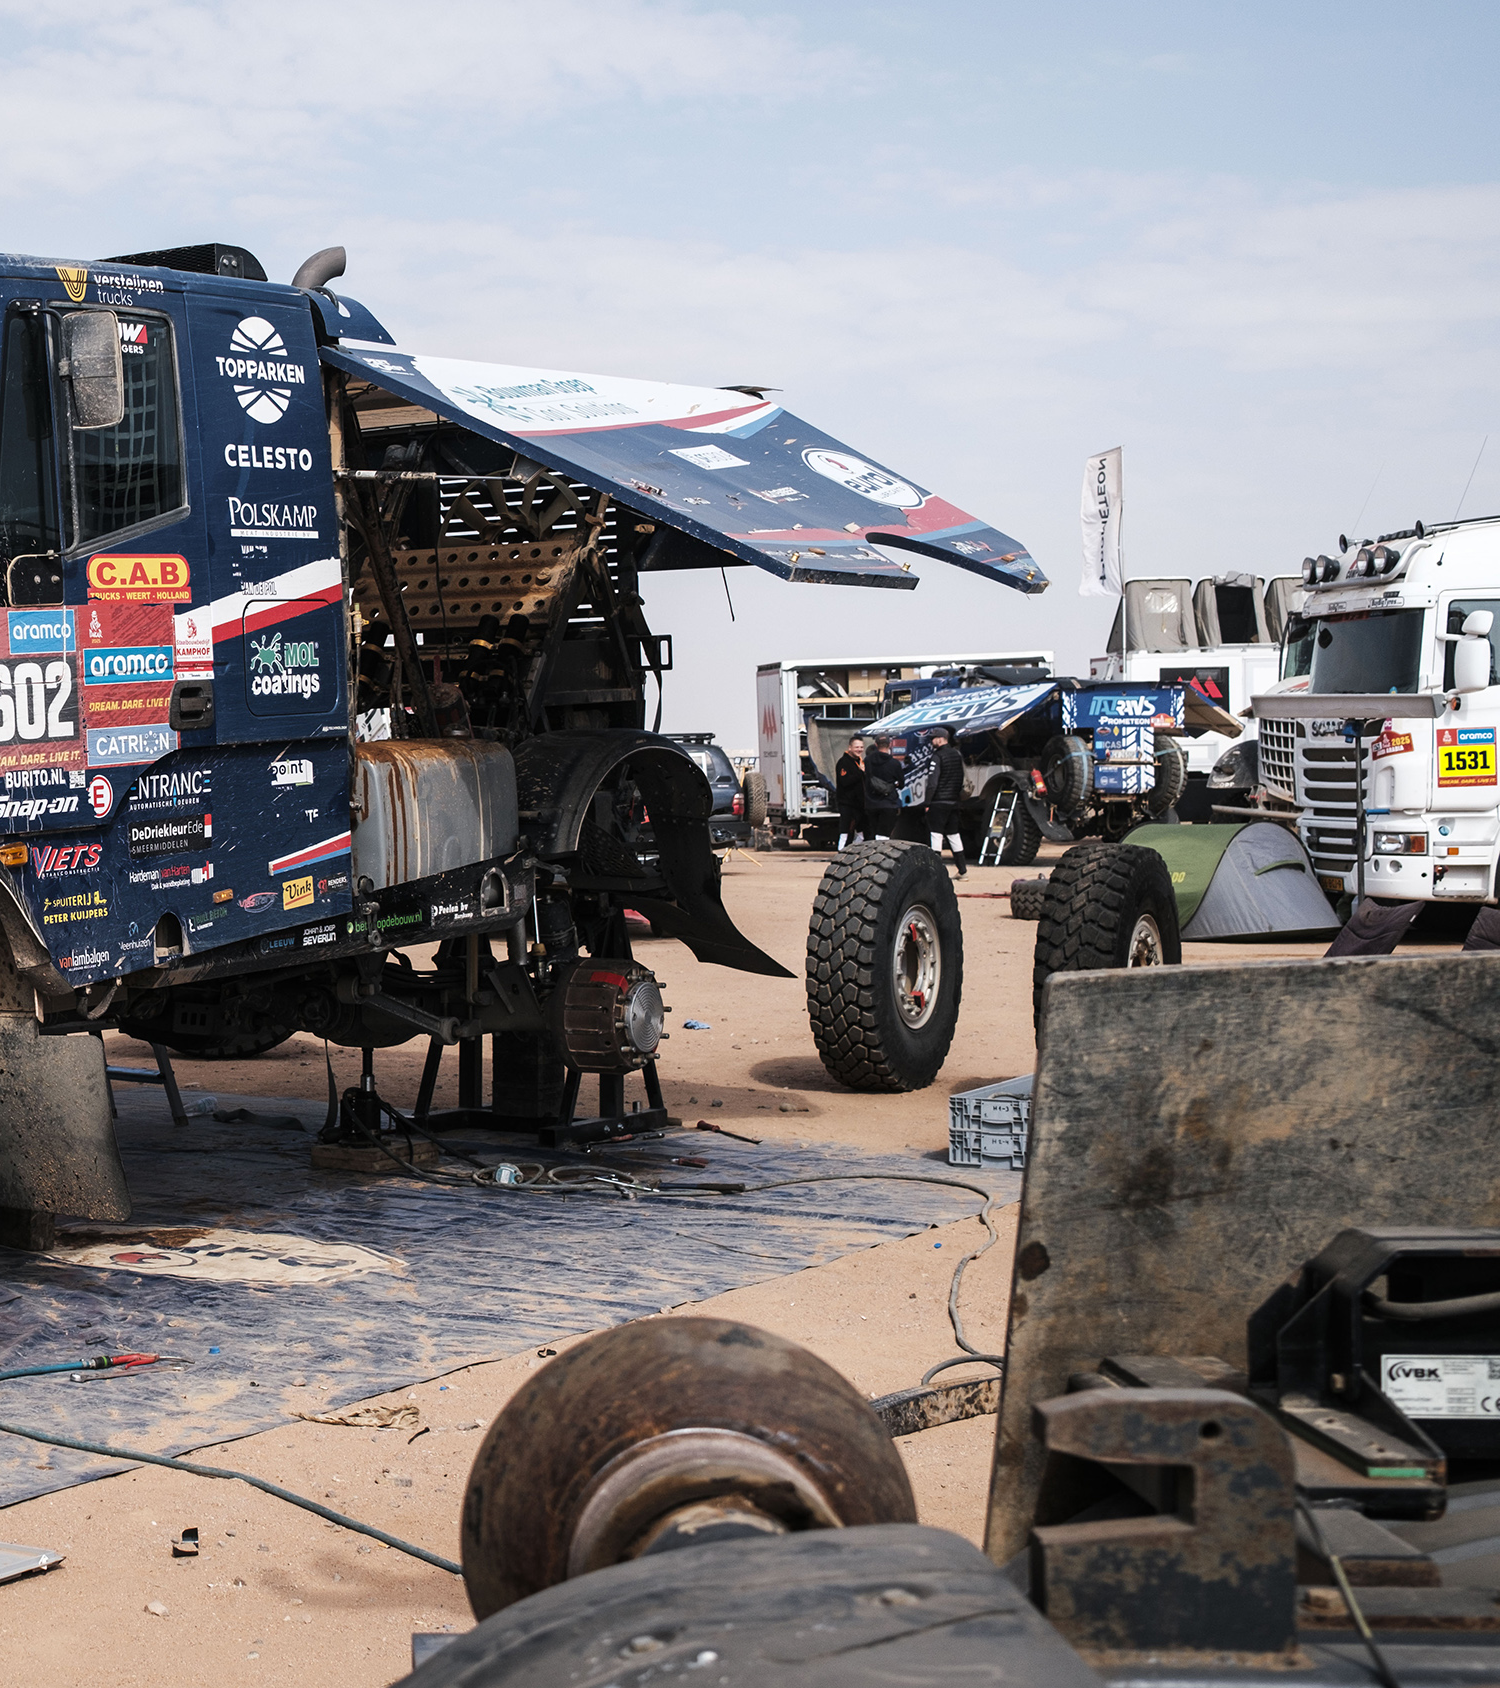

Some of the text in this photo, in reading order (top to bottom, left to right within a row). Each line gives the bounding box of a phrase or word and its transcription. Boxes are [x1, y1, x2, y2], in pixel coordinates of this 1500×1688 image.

[94, 274, 164, 295] versteijnen
[98, 290, 133, 306] trucks
[216, 356, 305, 385] TOPPARKEN
[225, 444, 312, 471] CELESTO
[844, 465, 897, 494] eurol
[228, 497, 317, 528] POLSKAMP
[96, 562, 180, 585] C.A.B
[90, 591, 189, 600] TRUCKS WEERT HOLLAND
[13, 624, 71, 640] aramco
[284, 642, 319, 667] MOL
[91, 654, 168, 677] aramco
[252, 668, 320, 699] coatings
[89, 701, 121, 712] DREAM.
[122, 700, 145, 710] DARE.
[146, 698, 164, 708] LIVE
[1099, 716, 1150, 726] PROMETEON
[1391, 736, 1411, 747] 2025
[1459, 732, 1492, 740] aramco
[20, 753, 48, 765] DARE.
[50, 751, 69, 763] LIVE
[70, 750, 81, 761] IT.
[1444, 750, 1490, 771] 1531
[5, 768, 65, 789] BURITO.NL
[130, 797, 200, 811] AUTOMATISCHE DEUREN
[132, 839, 189, 855] SMEERMIDDELEN
[32, 844, 102, 878] VIETS
[286, 880, 312, 899] Vink
[53, 892, 91, 907] SPUITERIJ
[44, 907, 108, 924] PETER KUIJPERS
[355, 909, 422, 933] betopdebouw.nl
[269, 937, 295, 949] LEEUW
[1402, 1368, 1440, 1378] VBK
